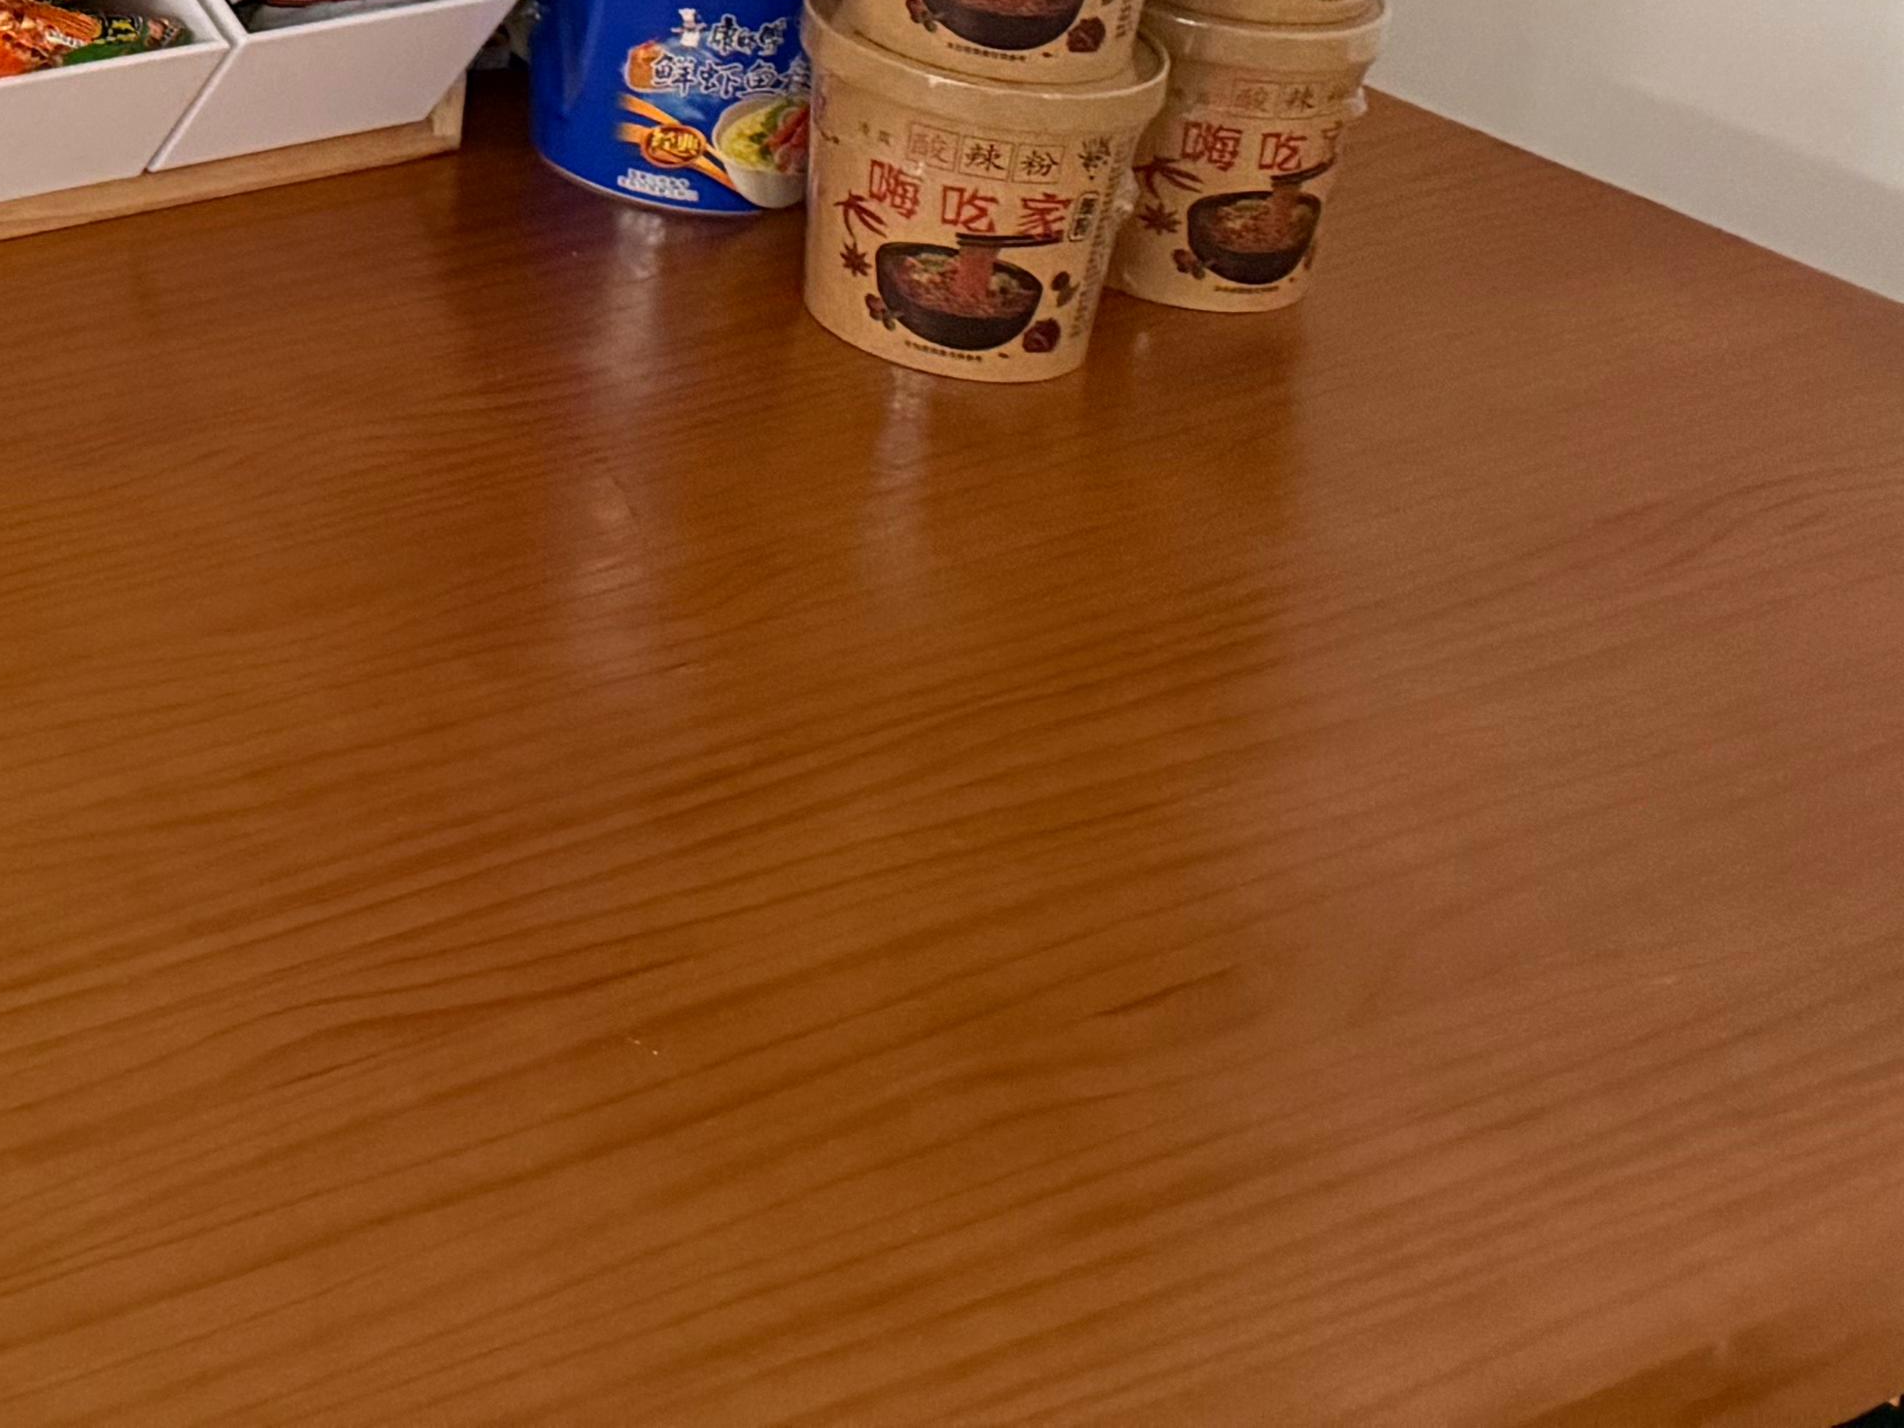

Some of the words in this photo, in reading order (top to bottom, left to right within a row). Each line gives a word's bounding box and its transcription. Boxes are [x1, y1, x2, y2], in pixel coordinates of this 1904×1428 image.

[650, 133, 702, 156] 经典
[910, 127, 1060, 177] 酸辣粉
[869, 158, 1073, 241] 嗨吃家
